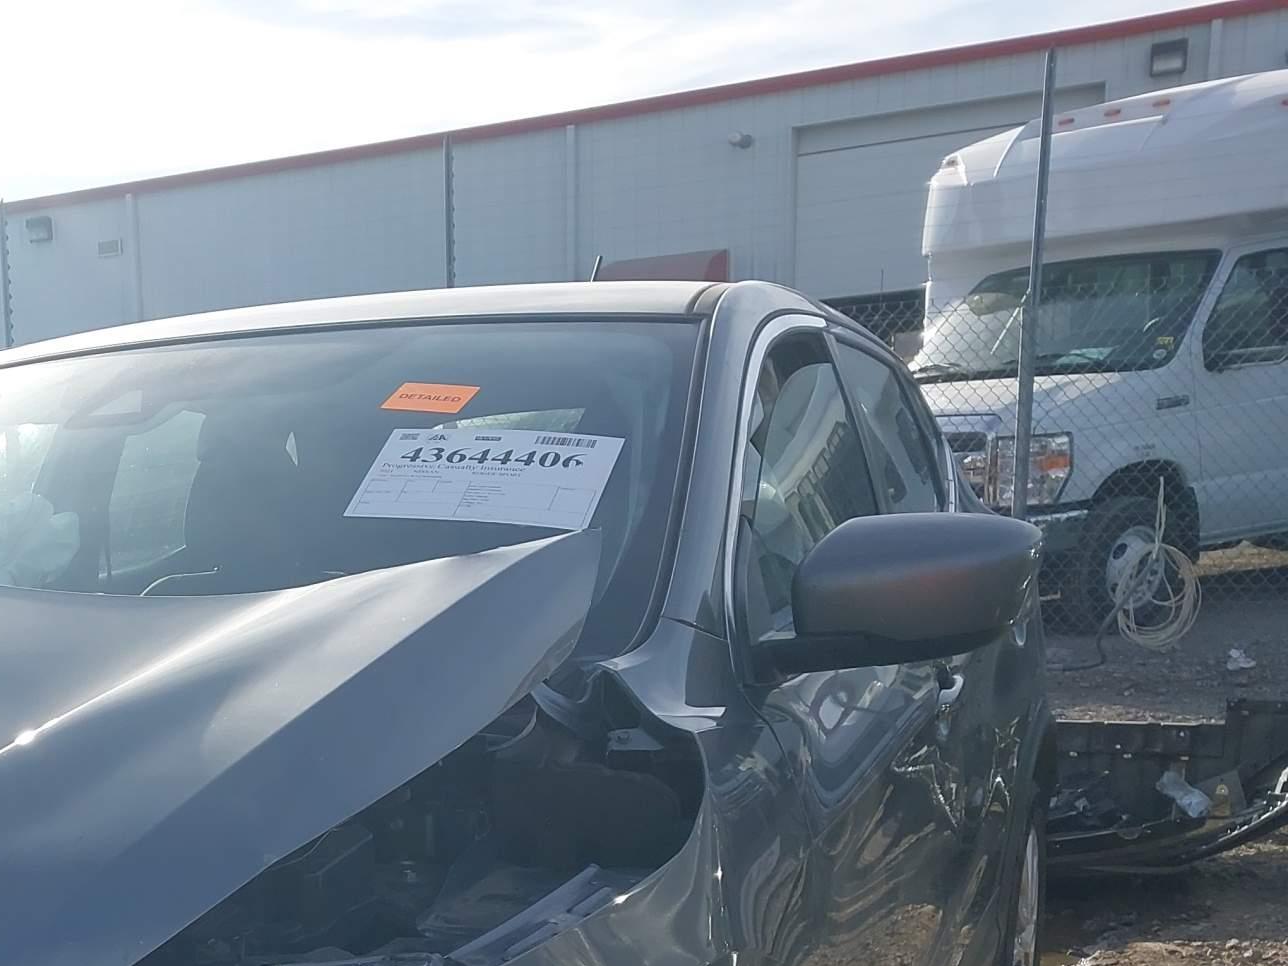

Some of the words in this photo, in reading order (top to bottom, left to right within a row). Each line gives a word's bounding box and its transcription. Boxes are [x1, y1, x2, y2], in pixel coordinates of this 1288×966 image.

[399, 393, 462, 403] DETAILED
[401, 446, 587, 468] 43644406
[480, 464, 526, 472] Insurance
